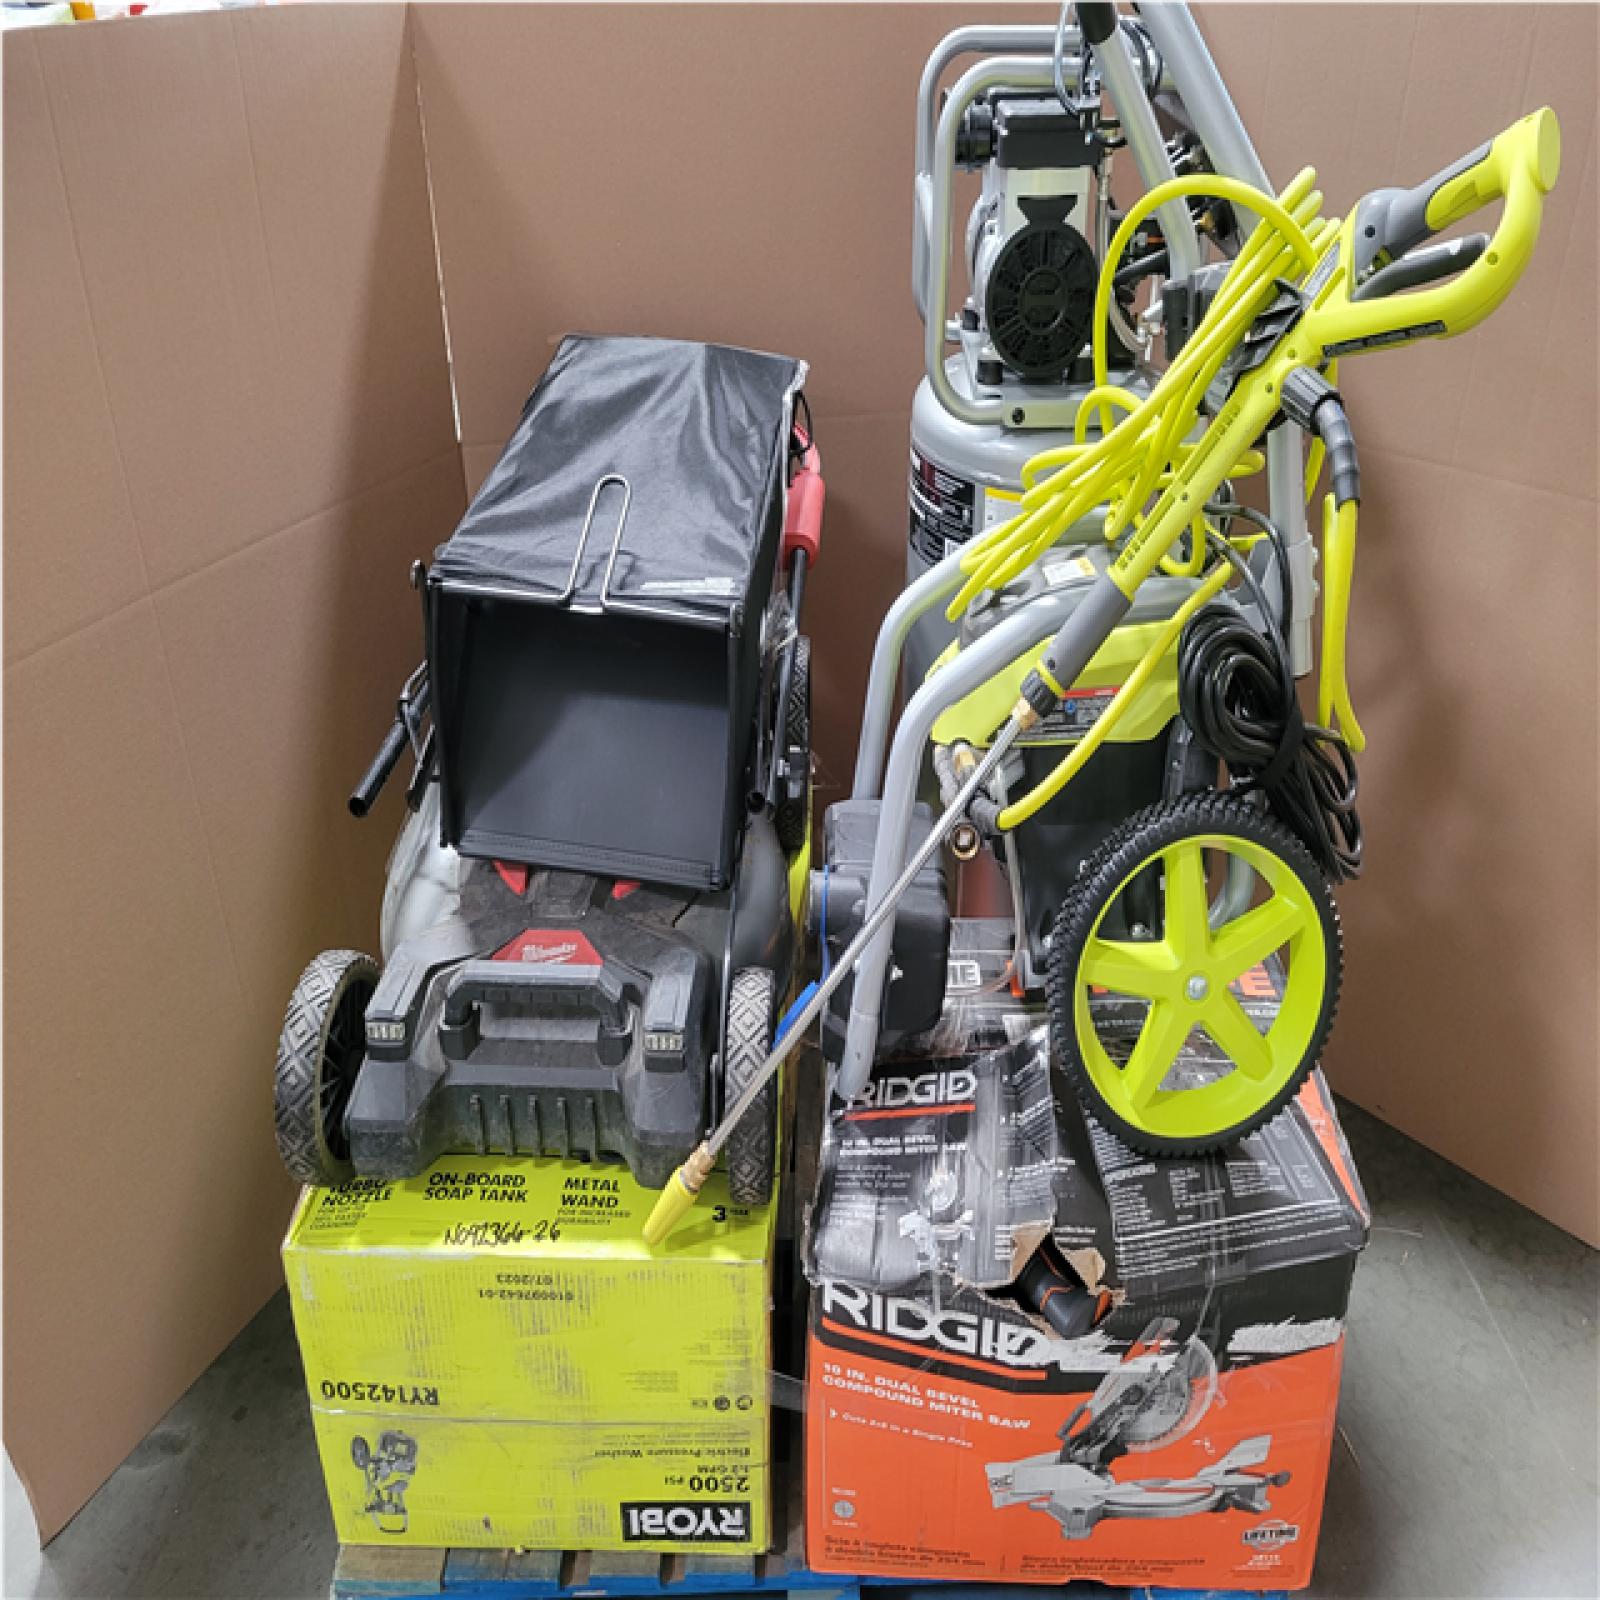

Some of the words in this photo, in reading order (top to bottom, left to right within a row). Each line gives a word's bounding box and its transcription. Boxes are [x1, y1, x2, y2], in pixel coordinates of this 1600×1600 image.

[429, 1172, 526, 1188] ON-BOARD
[564, 1177, 620, 1193] METAL
[321, 1188, 392, 1206] NOZZLE
[423, 1187, 473, 1201] SOAP
[479, 1189, 528, 1203] TANK
[561, 1194, 618, 1209] WAND
[712, 1205, 727, 1222] 3
[822, 1280, 1050, 1365] RIDGID
[321, 1380, 440, 1406] RY142500
[824, 1362, 841, 1376] 10
[847, 1368, 870, 1382] IN.
[874, 1374, 921, 1396] DUAL
[926, 1388, 981, 1408] BEVEL
[822, 1374, 924, 1407] COMPOUND
[929, 1400, 983, 1421] MITER
[988, 1414, 1031, 1429] SAW
[593, 1449, 643, 1460] Washer
[647, 1449, 701, 1459] Pressure
[707, 1448, 751, 1458] Electric
[697, 1465, 728, 1474] GPM
[664, 1475, 685, 1486] PSI
[689, 1476, 751, 1494] 2500
[629, 1506, 746, 1537] RYOBI
